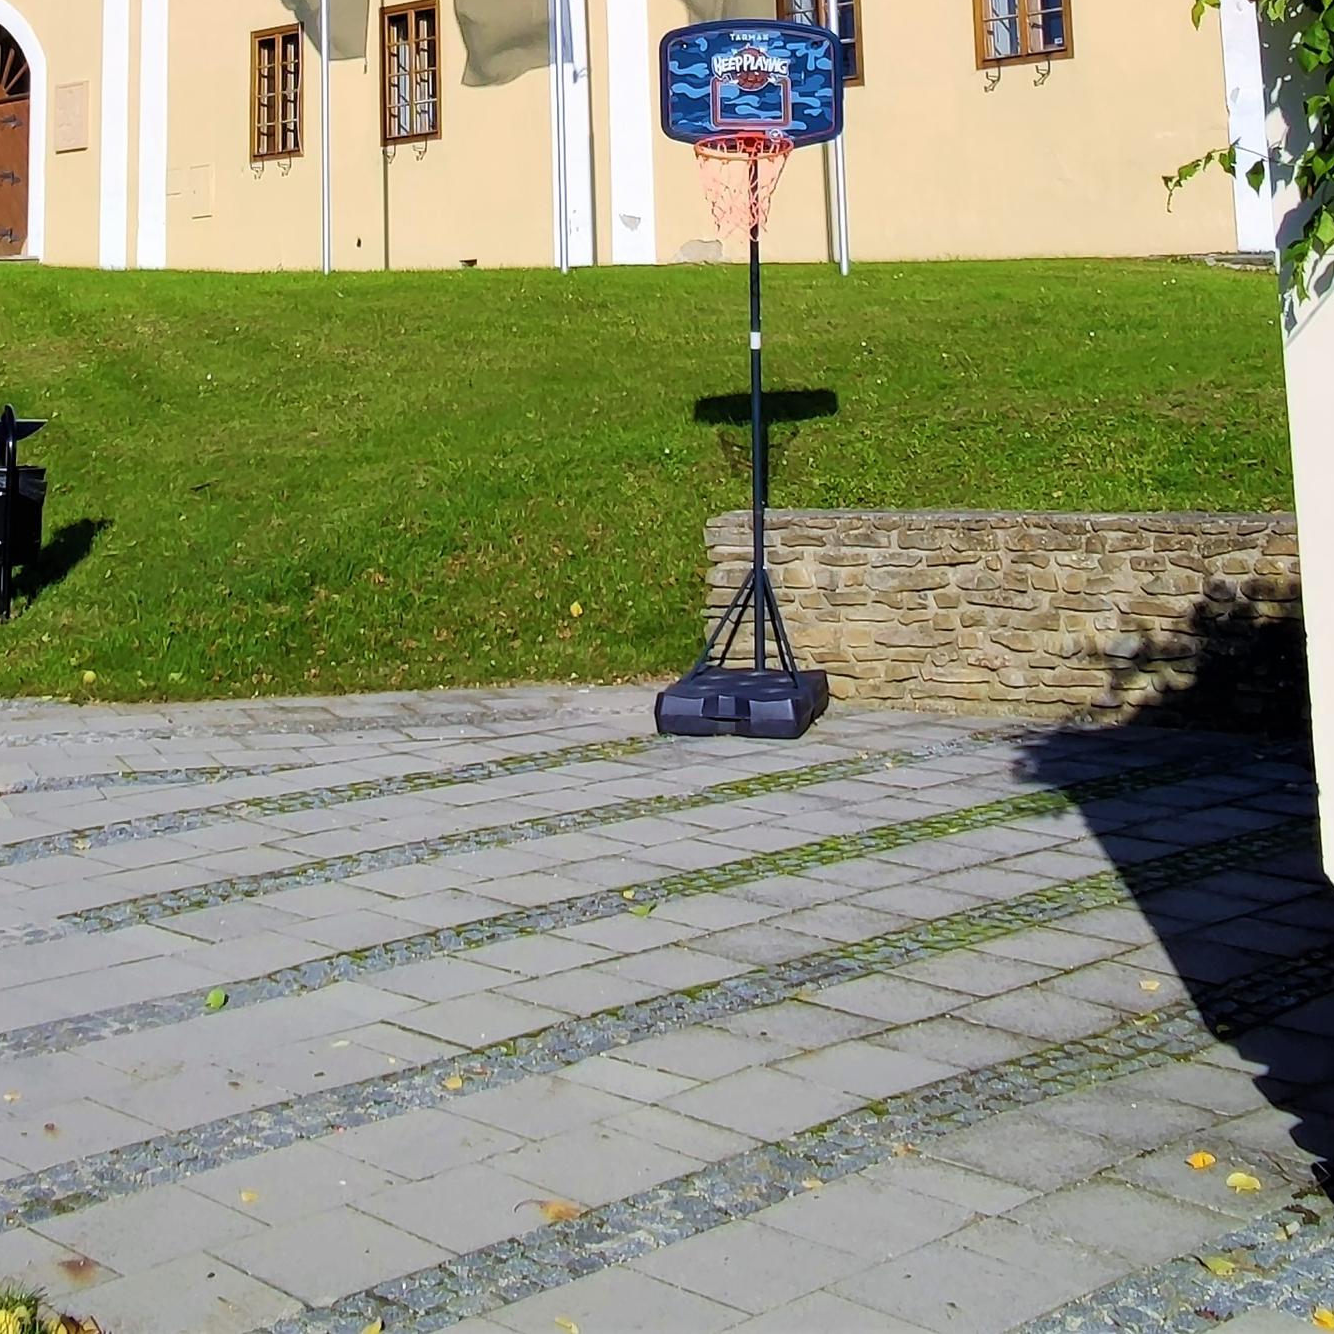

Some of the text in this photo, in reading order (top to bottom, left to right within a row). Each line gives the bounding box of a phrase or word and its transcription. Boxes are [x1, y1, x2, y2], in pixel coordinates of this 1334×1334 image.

[729, 33, 769, 41] TARMAK
[713, 53, 788, 77] KEEP PLAYING
